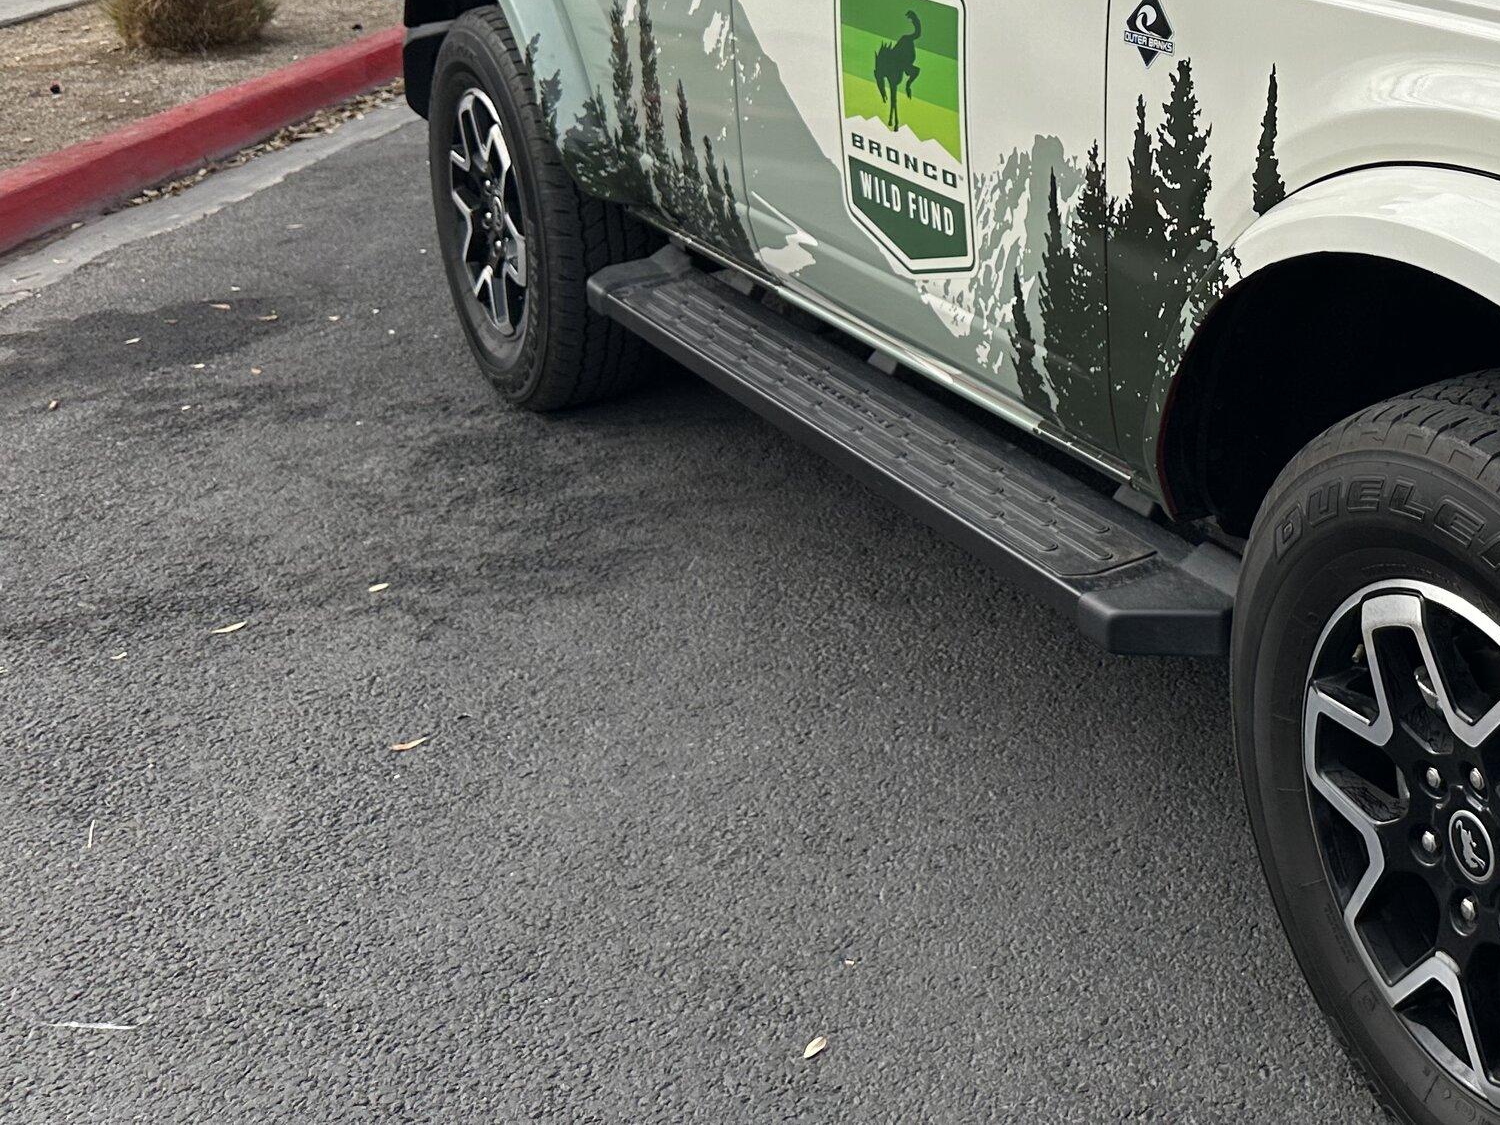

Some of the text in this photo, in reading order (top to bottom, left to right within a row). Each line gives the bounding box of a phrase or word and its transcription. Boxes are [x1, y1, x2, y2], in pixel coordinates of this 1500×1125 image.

[1125, 32, 1173, 53] OUTER BANKS
[851, 132, 957, 189] BRONCO
[860, 170, 954, 236] WILD FUND
